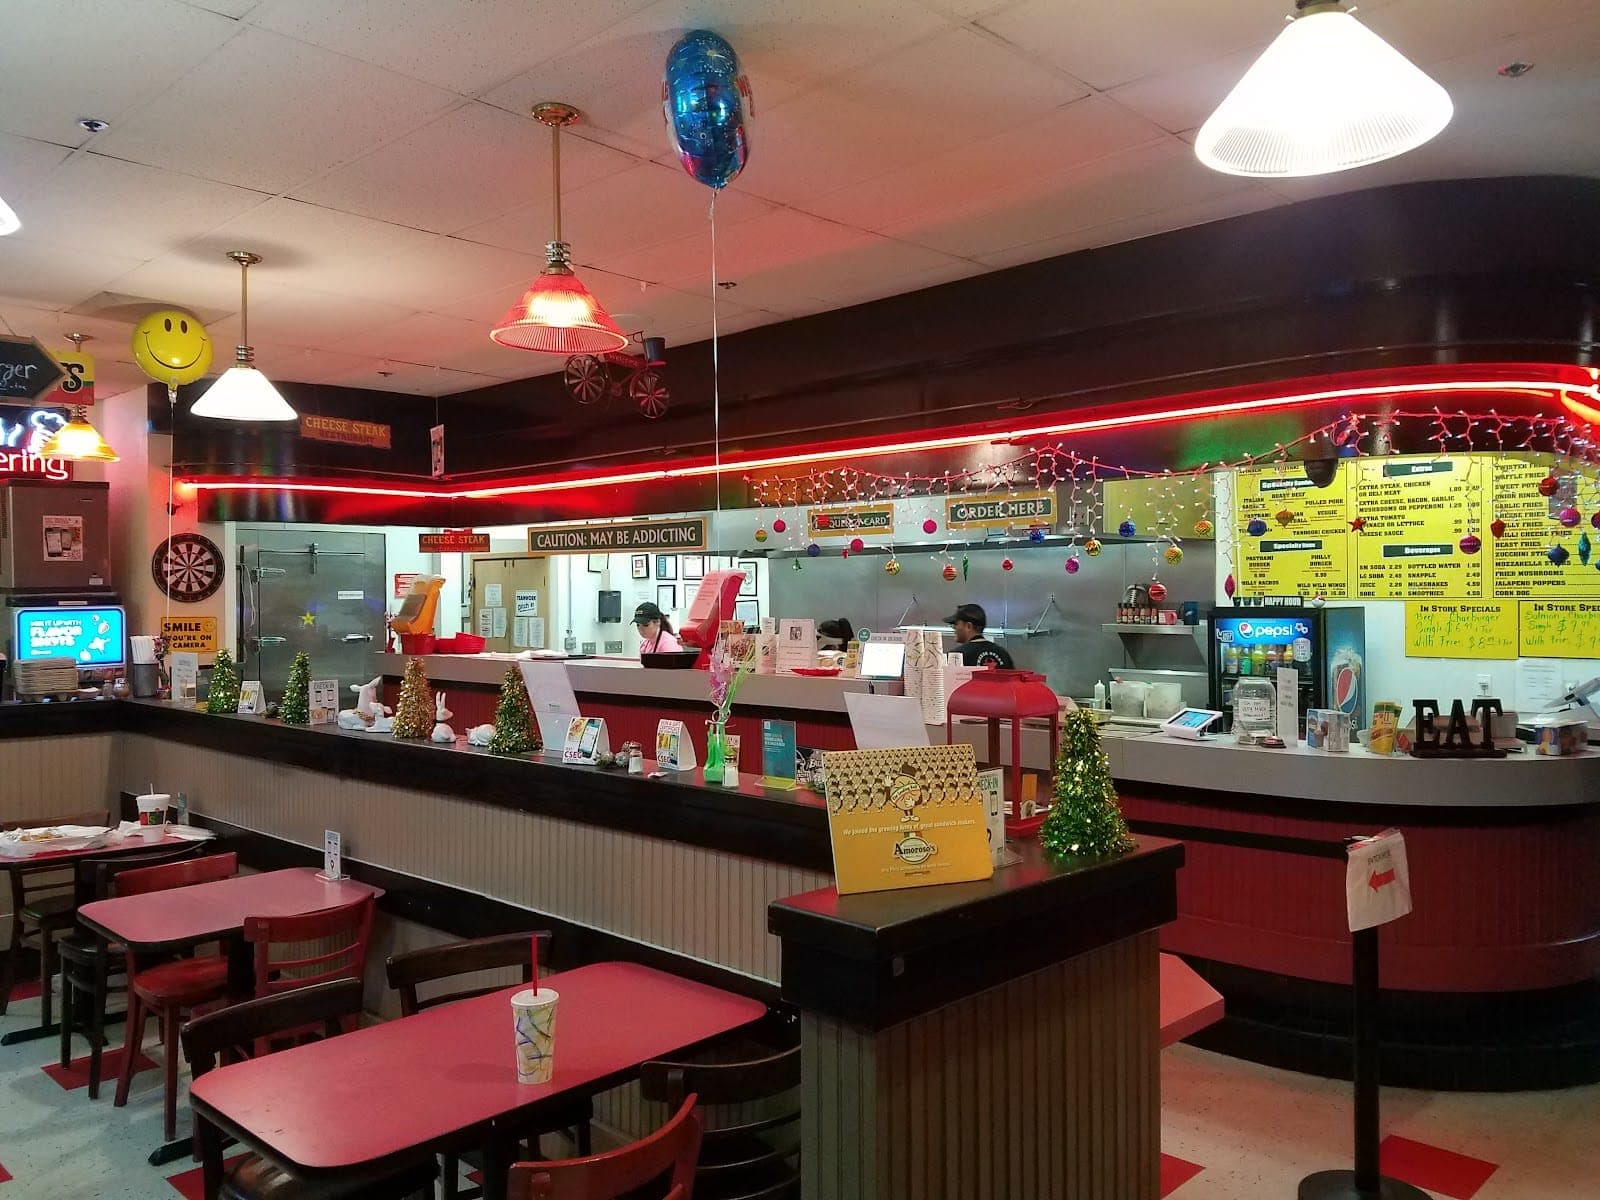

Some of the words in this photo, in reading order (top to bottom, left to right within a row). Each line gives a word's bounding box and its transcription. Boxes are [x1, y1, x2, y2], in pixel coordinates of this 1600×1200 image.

[305, 416, 348, 432] CHEESE
[352, 423, 386, 438] STEAK
[1408, 502, 1444, 510] PEPPERONI
[956, 507, 1001, 523] ORDER
[1379, 514, 1406, 522] TOMATO
[864, 517, 887, 526] CARD
[1396, 519, 1425, 527] LETTUCE
[1321, 528, 1346, 536] CHICKEN
[1383, 529, 1404, 537] SAUCE
[422, 535, 455, 545] CHEESE
[458, 535, 485, 545] STEAK
[536, 532, 589, 549] CAUTION:
[590, 530, 615, 546] MAY
[616, 529, 630, 544] BE
[632, 526, 697, 544] ADDICTING
[1420, 605, 1429, 613] IN
[1431, 604, 1457, 613] STORE
[1460, 604, 1501, 613] SPECIALS
[1547, 603, 1576, 612] STORE
[163, 622, 202, 633] SMILE
[1255, 622, 1294, 639] pepsi
[200, 633, 213, 641] ON
[172, 641, 206, 650] CAMERA
[1412, 698, 1503, 752] EAT
[894, 843, 936, 857] Amoroso's
